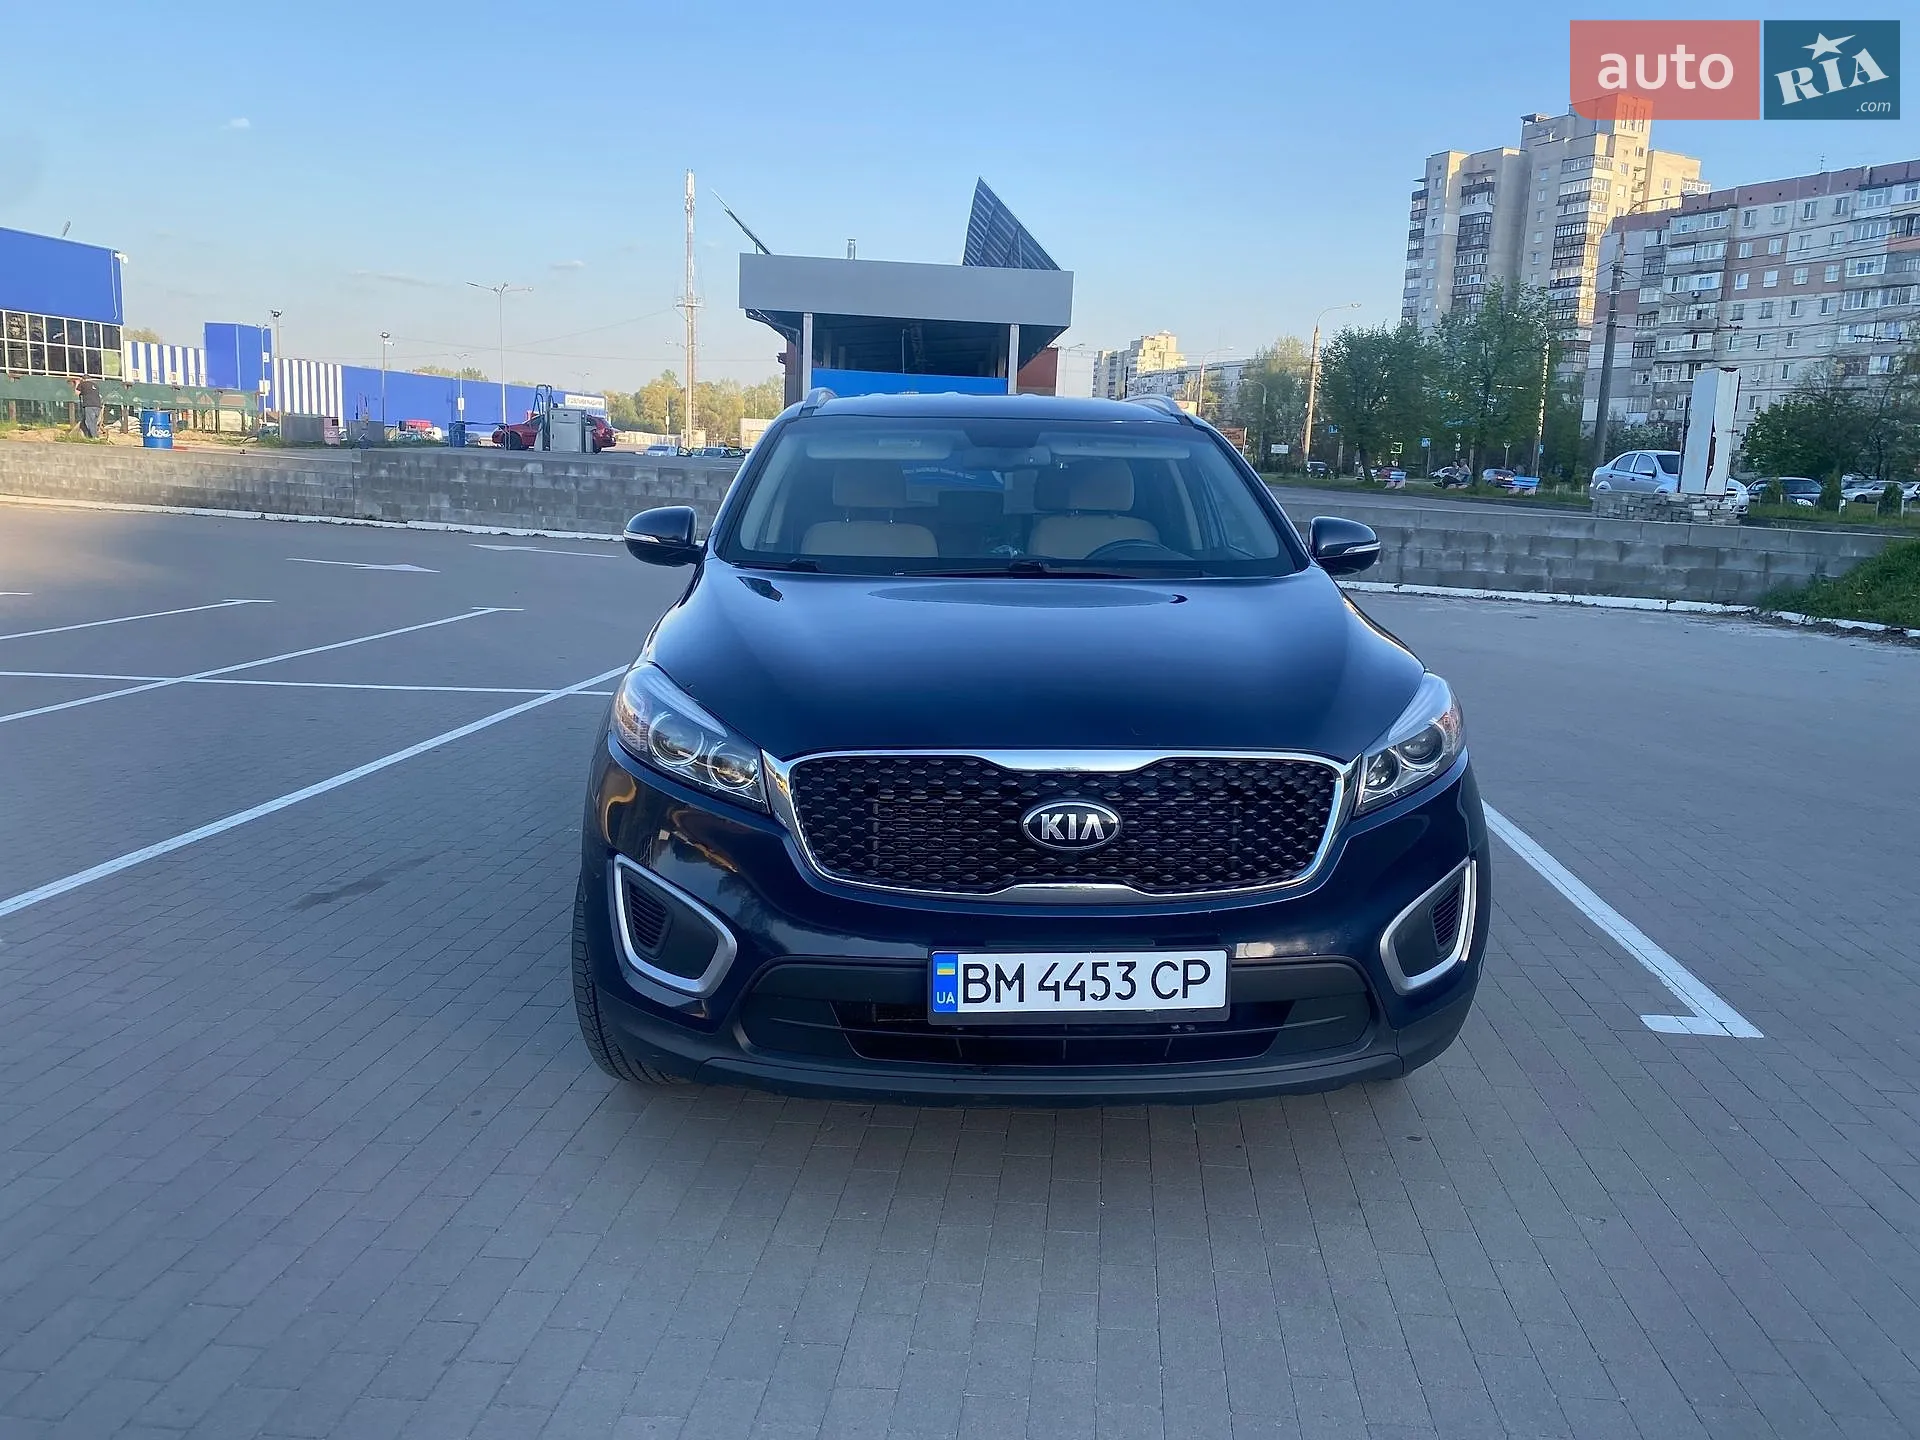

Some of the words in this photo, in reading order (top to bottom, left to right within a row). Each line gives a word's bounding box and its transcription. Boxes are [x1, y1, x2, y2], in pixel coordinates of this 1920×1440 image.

[1040, 813, 1105, 840] KIA
[962, 962, 1025, 1004] BM
[1037, 960, 1138, 1002] 4453
[1150, 959, 1212, 1000] CP
[936, 991, 956, 1004] UA
